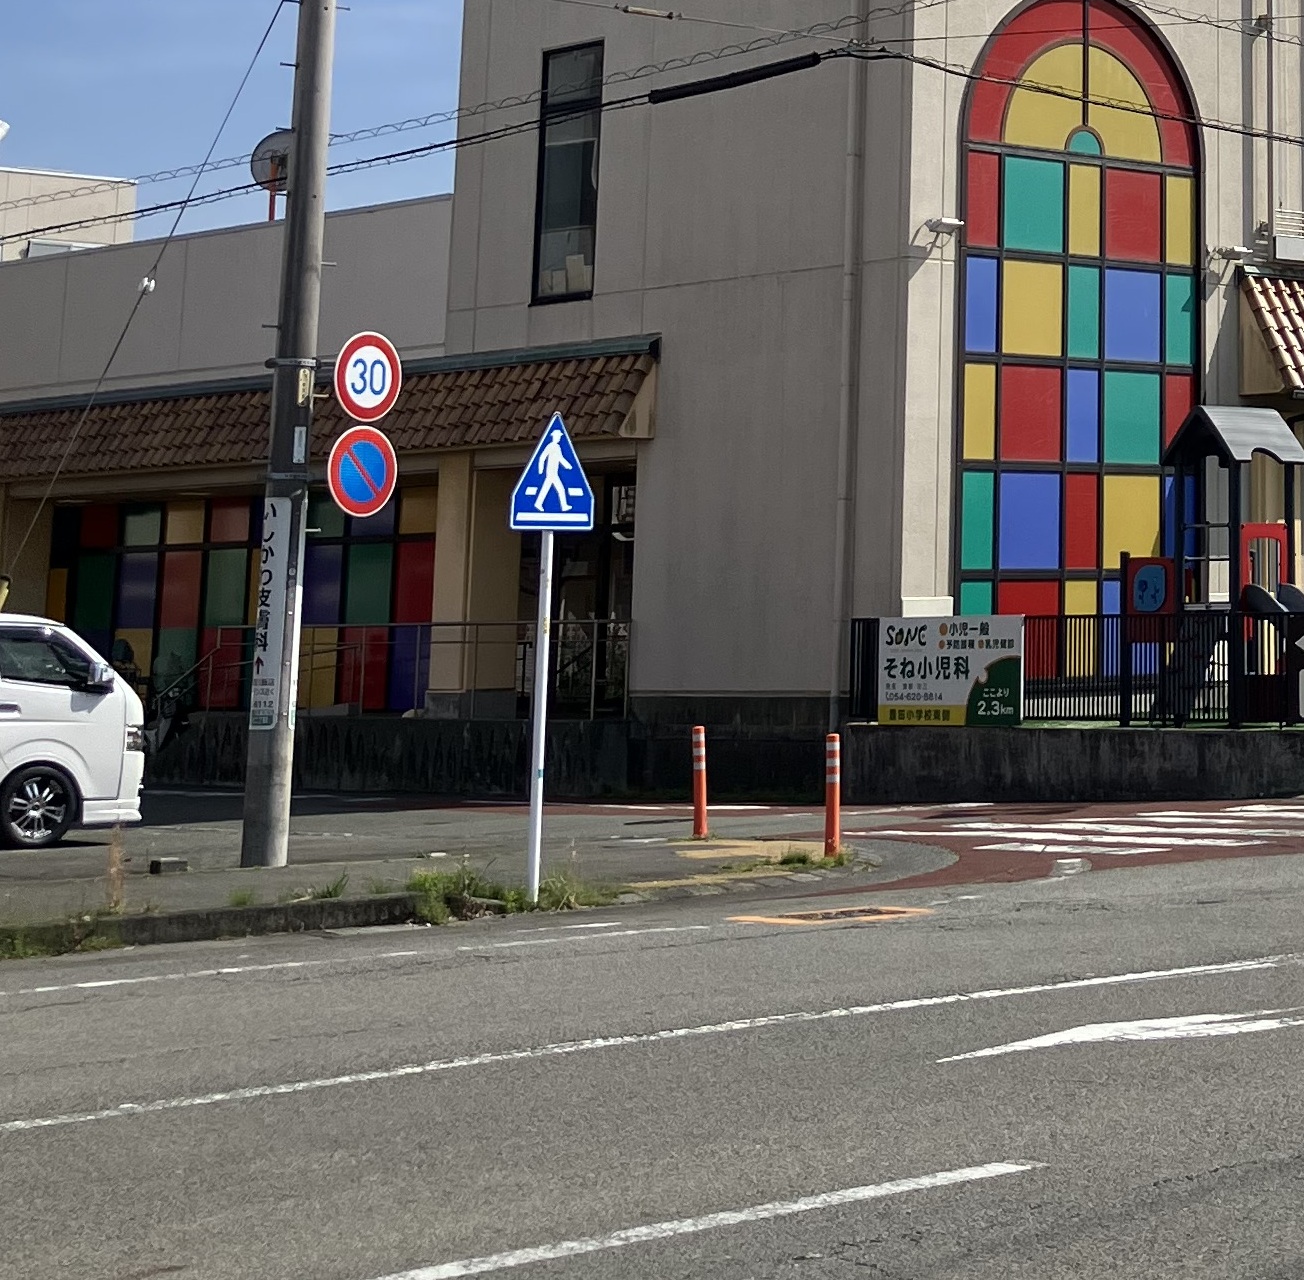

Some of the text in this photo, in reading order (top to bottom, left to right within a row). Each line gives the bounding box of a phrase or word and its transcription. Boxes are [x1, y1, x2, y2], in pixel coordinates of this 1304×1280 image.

[351, 358, 386, 395] 30
[884, 655, 970, 680] そね小児科
[982, 687, 1010, 698] ここより
[977, 700, 1014, 716] 2.3km
